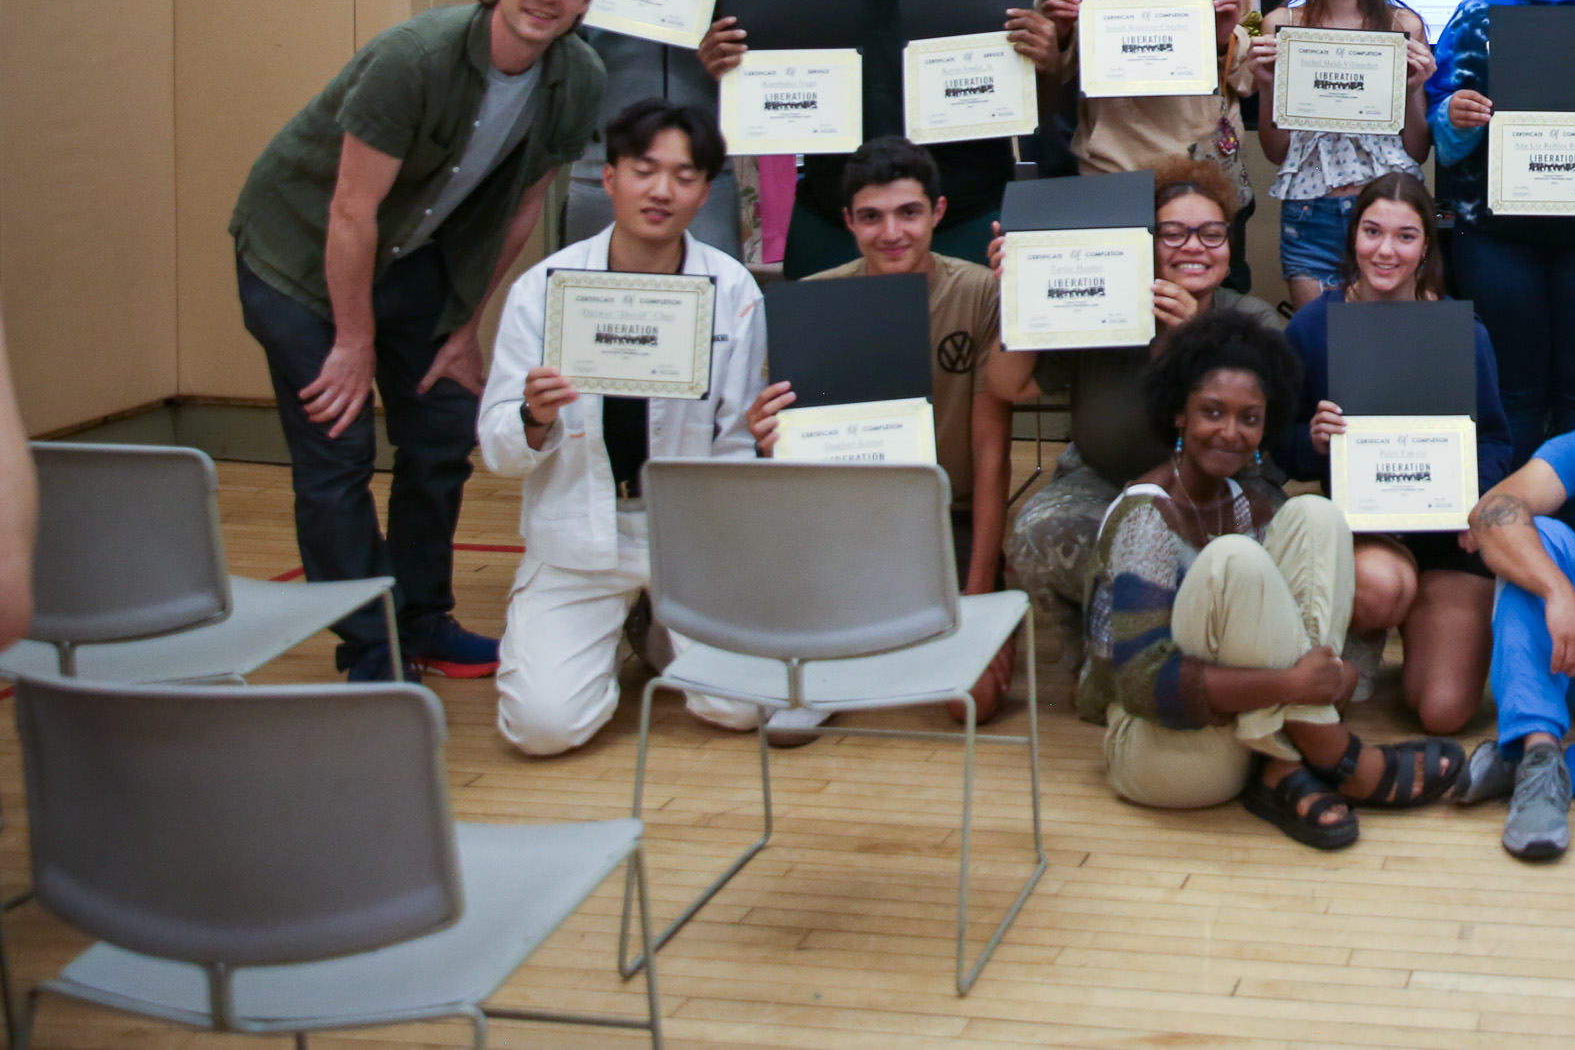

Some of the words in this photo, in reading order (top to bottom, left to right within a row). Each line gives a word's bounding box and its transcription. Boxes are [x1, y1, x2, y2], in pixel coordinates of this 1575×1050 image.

[1122, 35, 1173, 44] LIBERATION
[1314, 71, 1364, 81] LIBERATION
[945, 76, 994, 87] LIBERATION
[765, 92, 818, 101] LIBERATION
[1048, 277, 1106, 288] LIBERATION
[596, 323, 659, 334] LIBERATION
[1376, 463, 1431, 471] LIBERATION
